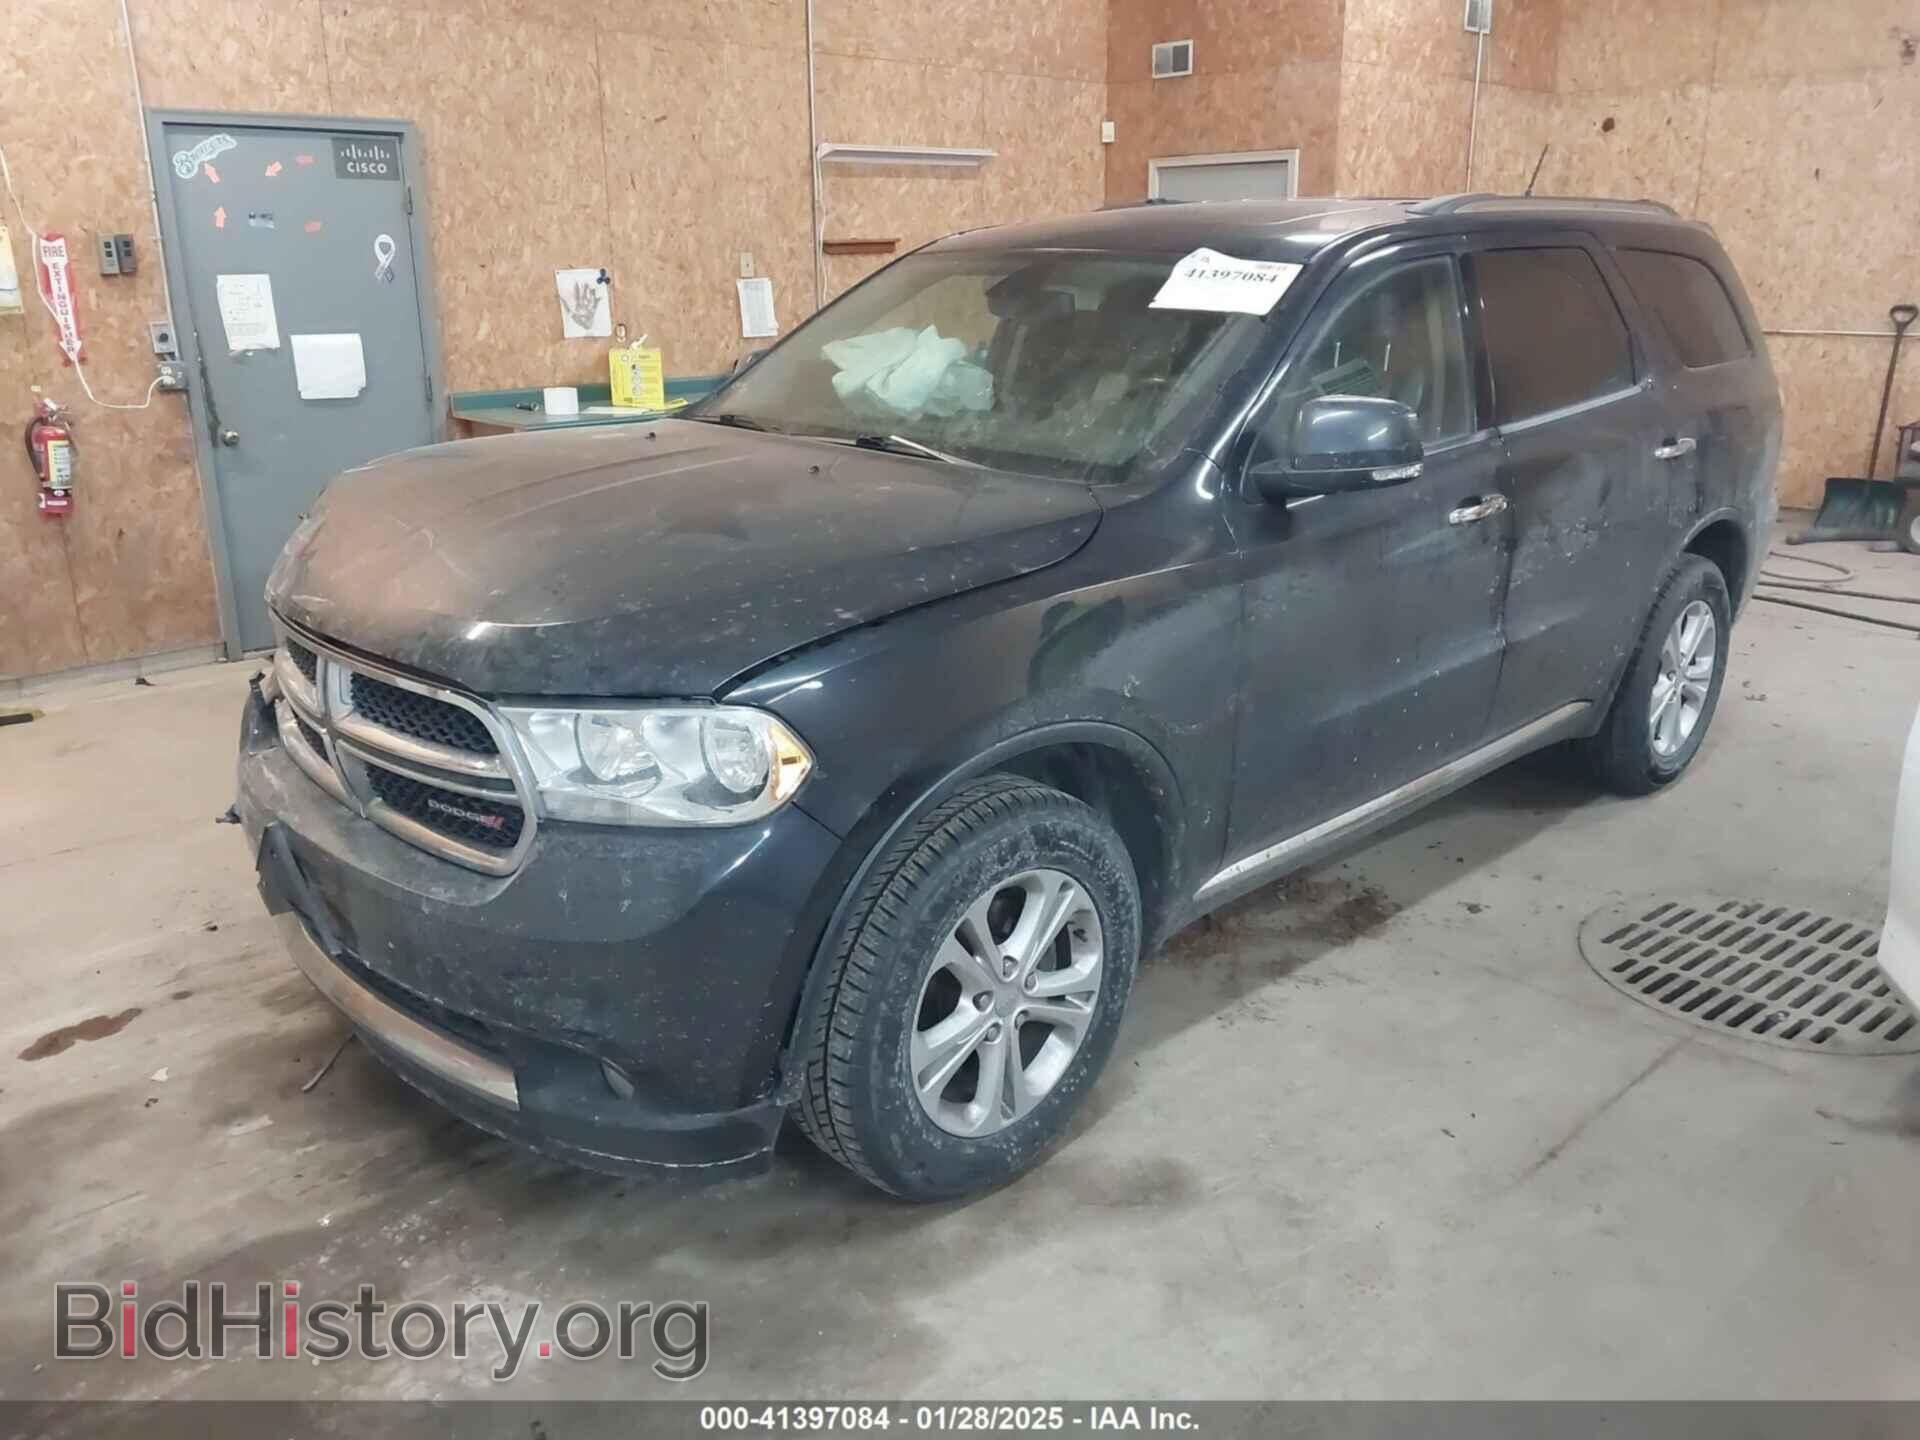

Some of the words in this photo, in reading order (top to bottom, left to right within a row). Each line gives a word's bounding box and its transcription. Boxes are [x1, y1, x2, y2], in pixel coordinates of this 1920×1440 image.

[346, 161, 388, 174] CISCO
[42, 245, 65, 258] FIRE
[1184, 268, 1280, 284] 41397084
[51, 261, 76, 353] EXTINGUISHER
[427, 799, 496, 828] DODGE
